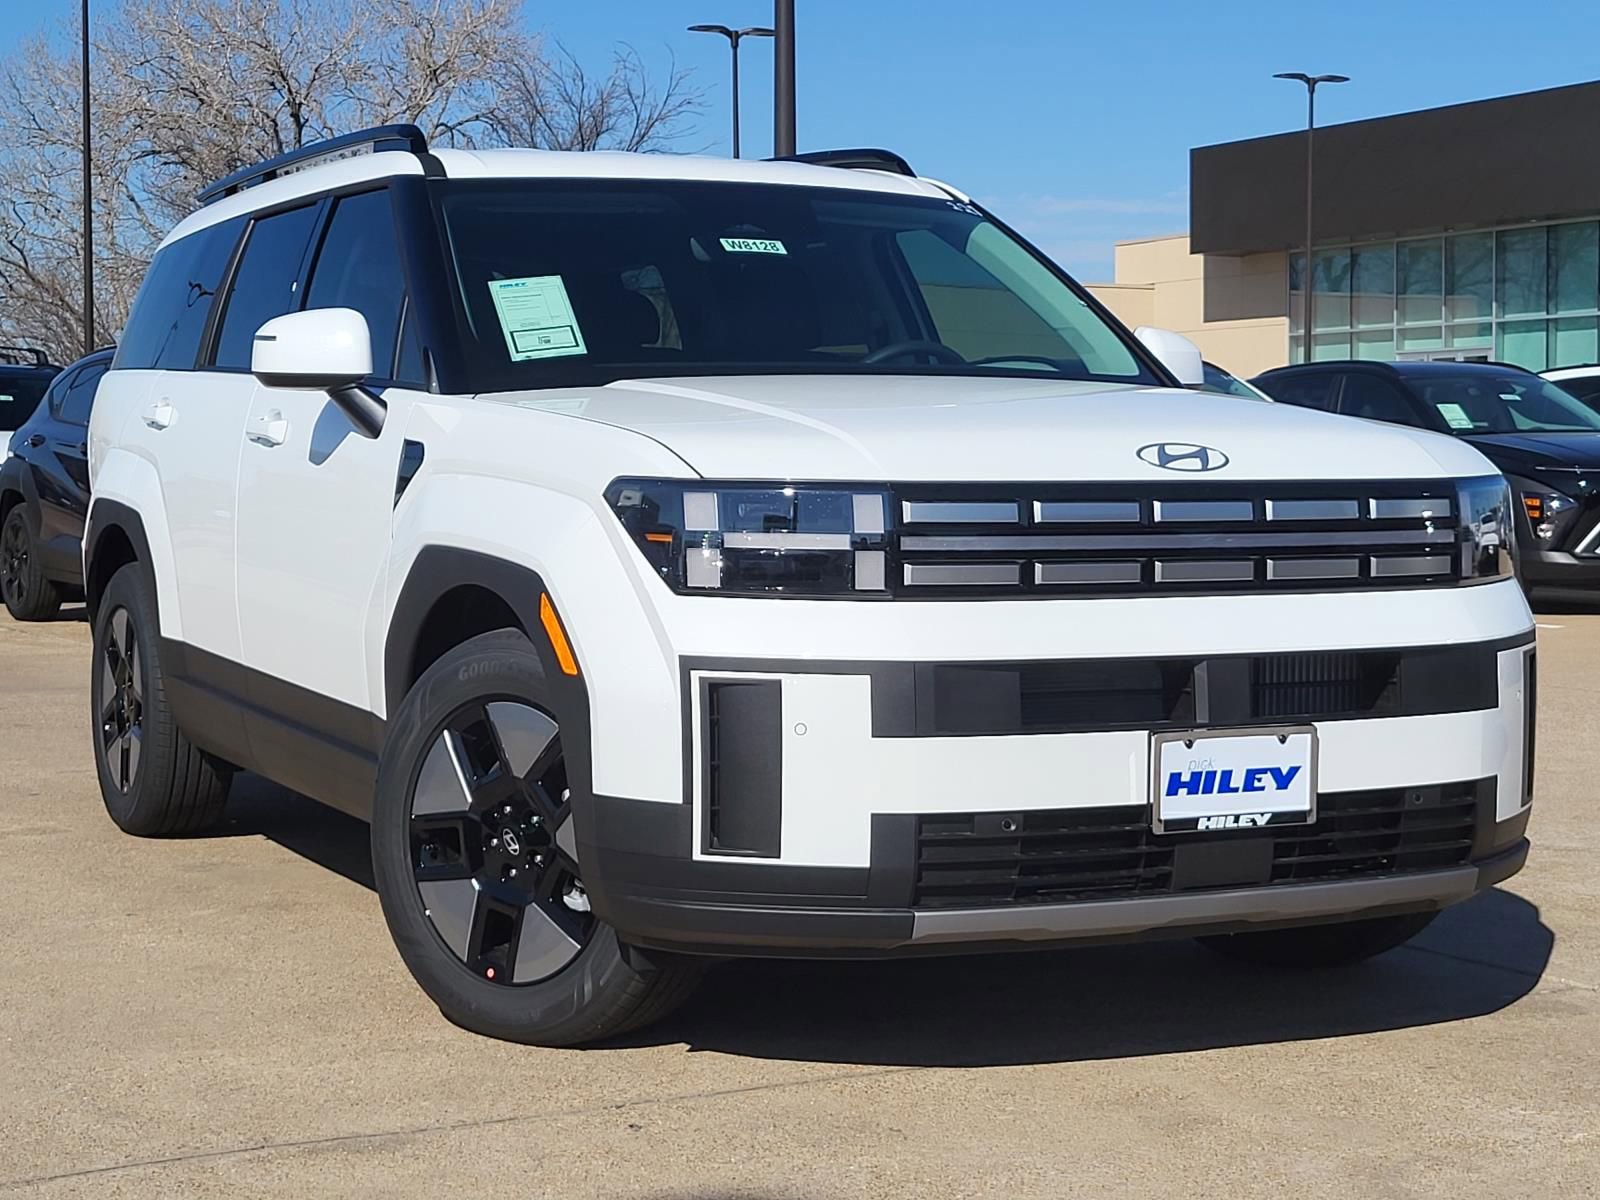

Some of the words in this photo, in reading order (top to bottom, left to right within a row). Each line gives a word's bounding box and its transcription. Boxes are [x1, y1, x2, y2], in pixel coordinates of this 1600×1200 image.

[724, 239, 780, 252] W8128
[1165, 765, 1302, 797] HILEY
[1197, 812, 1273, 831] HILEY
